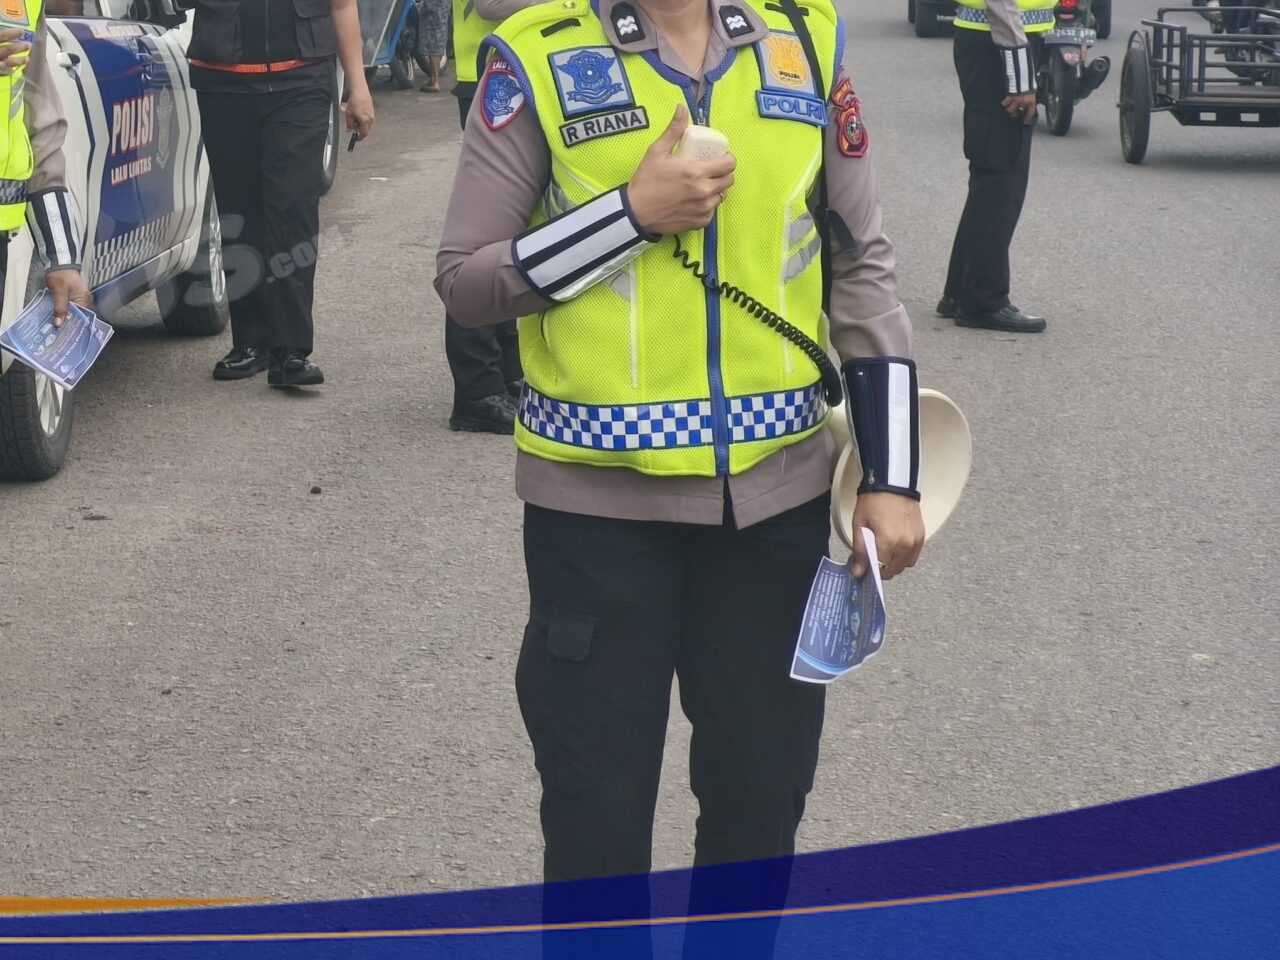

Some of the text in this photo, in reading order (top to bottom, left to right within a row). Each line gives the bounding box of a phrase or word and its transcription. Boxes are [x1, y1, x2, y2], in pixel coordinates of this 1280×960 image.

[763, 94, 827, 123] POLRI
[111, 94, 154, 157] POLISI
[566, 112, 643, 142] R RIANA
[111, 155, 152, 186] LALU LINTAS
